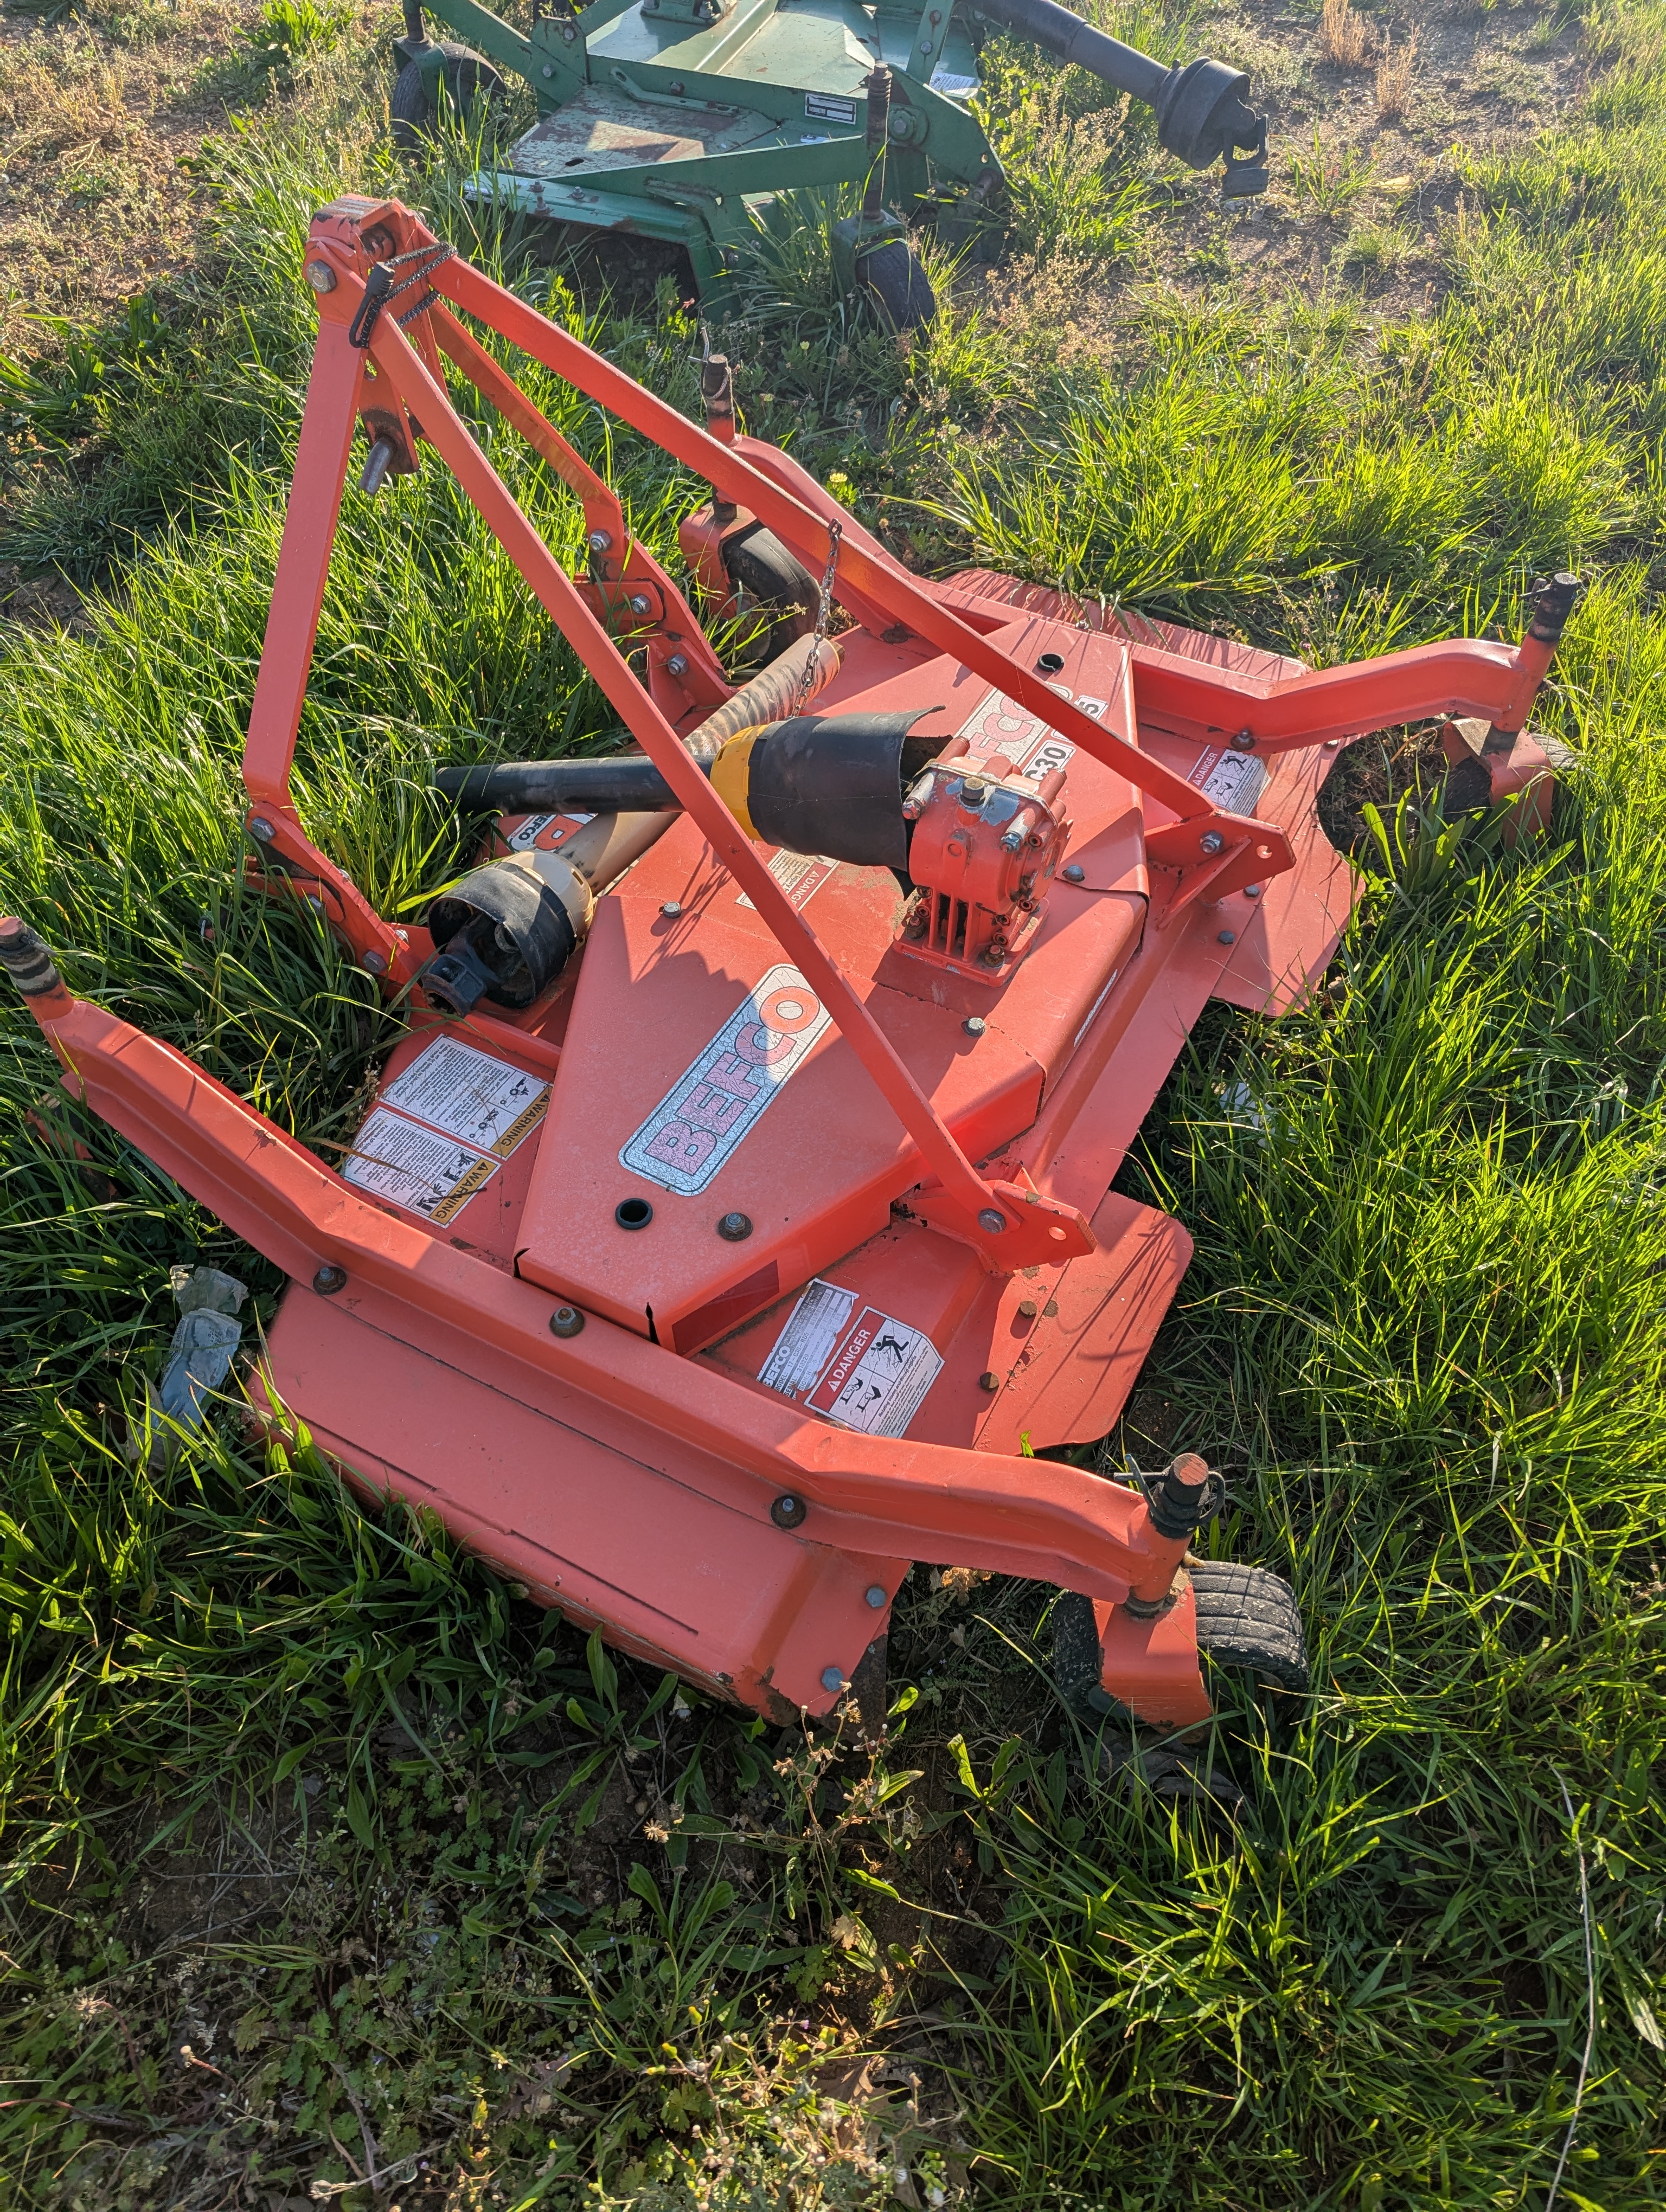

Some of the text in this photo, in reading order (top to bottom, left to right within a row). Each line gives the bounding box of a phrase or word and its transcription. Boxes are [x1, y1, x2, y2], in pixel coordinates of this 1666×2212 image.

[1024, 747, 1067, 781] C30
[1196, 752, 1218, 780] DANGER
[784, 875, 800, 888] injury
[790, 877, 817, 905] DANG
[796, 863, 812, 876] Avoid
[643, 986, 821, 1176] BEFCO
[374, 1124, 388, 1139] Failure
[499, 1102, 544, 1147] WARNING
[404, 1146, 459, 1205] Crushing and Pincing Hazard
[434, 1169, 483, 1220] WARNING
[761, 1344, 792, 1387] BEFCO
[832, 1327, 871, 1380] DANGER
[877, 1400, 890, 1418] Rotating
[887, 1388, 898, 1401] blades
[906, 1354, 917, 1369] objects
